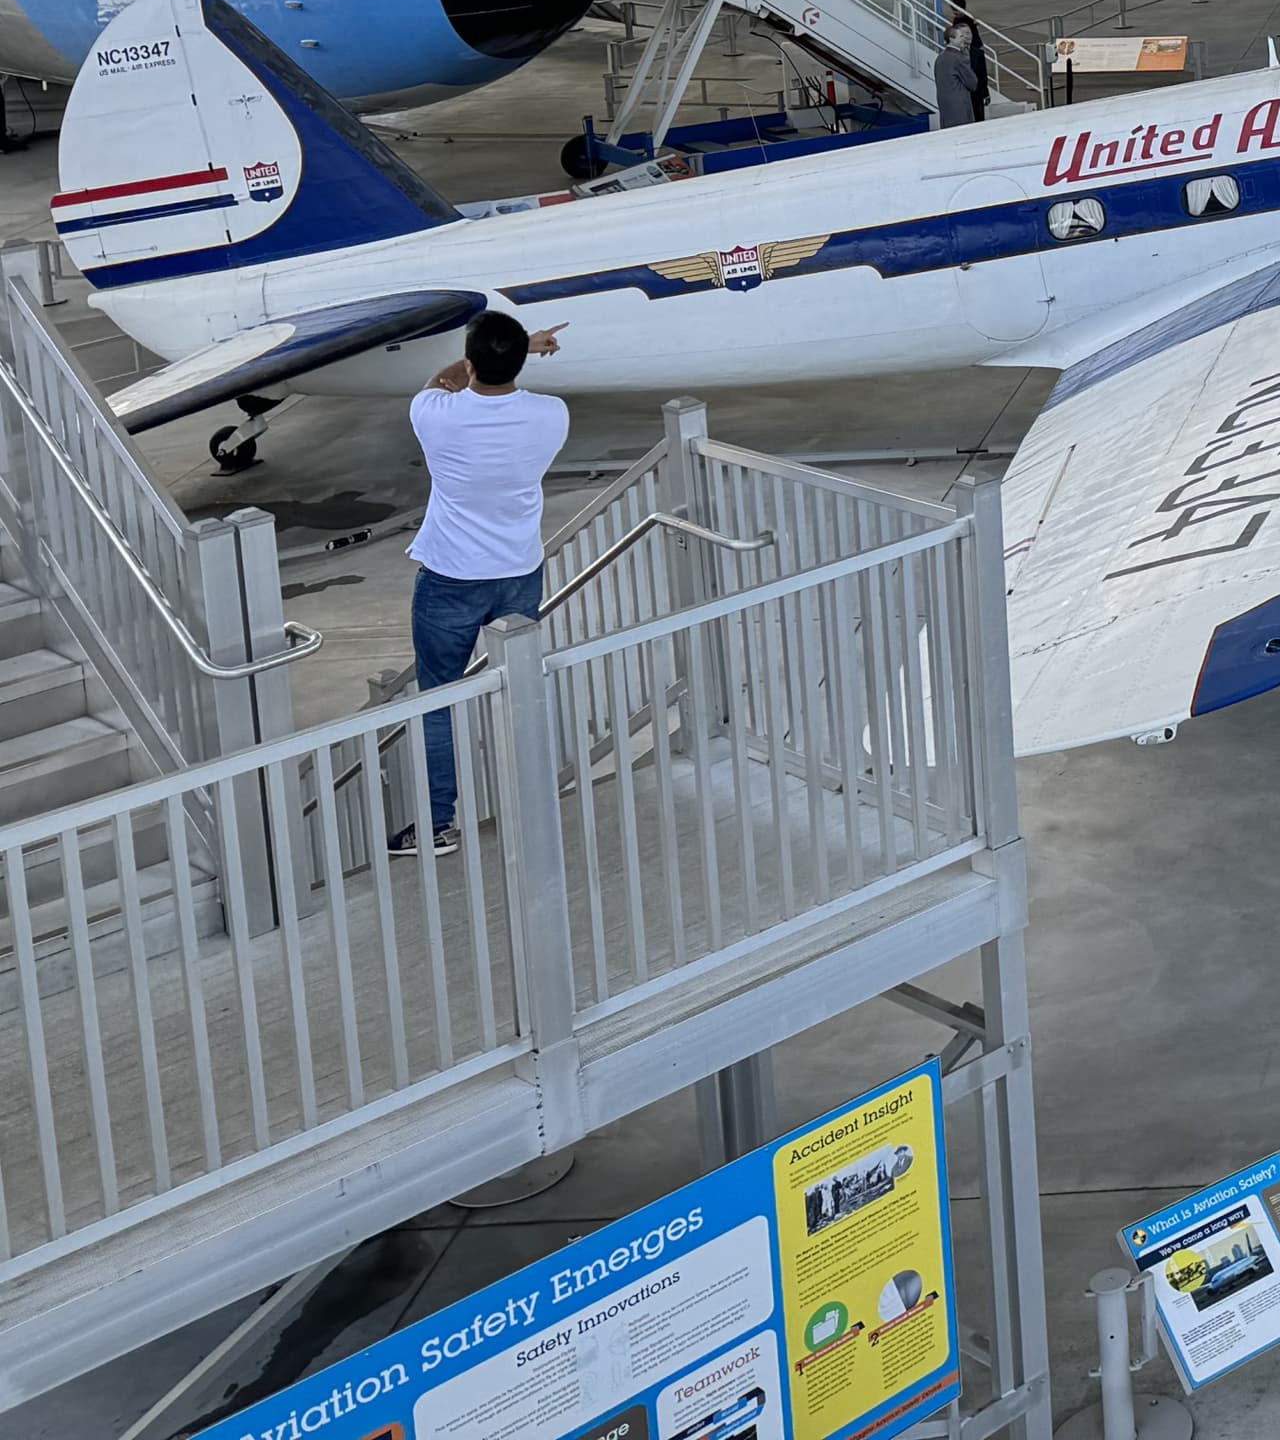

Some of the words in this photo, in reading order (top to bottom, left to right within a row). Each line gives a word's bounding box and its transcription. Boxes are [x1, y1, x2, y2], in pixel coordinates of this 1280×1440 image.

[97, 41, 170, 67] NC13347
[245, 164, 278, 179] UNITED
[1042, 113, 1223, 187] United
[721, 250, 757, 264] UNITED
[789, 1119, 860, 1165] Accident
[863, 1089, 913, 1127] Insight
[1148, 1215, 1180, 1235] What
[1182, 1208, 1192, 1221] is
[1193, 1187, 1238, 1214] Aviation
[1238, 1164, 1277, 1191] Safety?
[1159, 1242, 1182, 1257] We've
[1182, 1231, 1203, 1246] come
[1204, 1227, 1211, 1235] a
[1210, 1219, 1228, 1234] long
[1228, 1209, 1245, 1224] way
[421, 1291, 540, 1373] Safety
[550, 1206, 704, 1305] Emerges
[516, 1328, 572, 1368] Safety
[577, 1271, 681, 1335] Innovations
[674, 1346, 761, 1404] Teamwork
